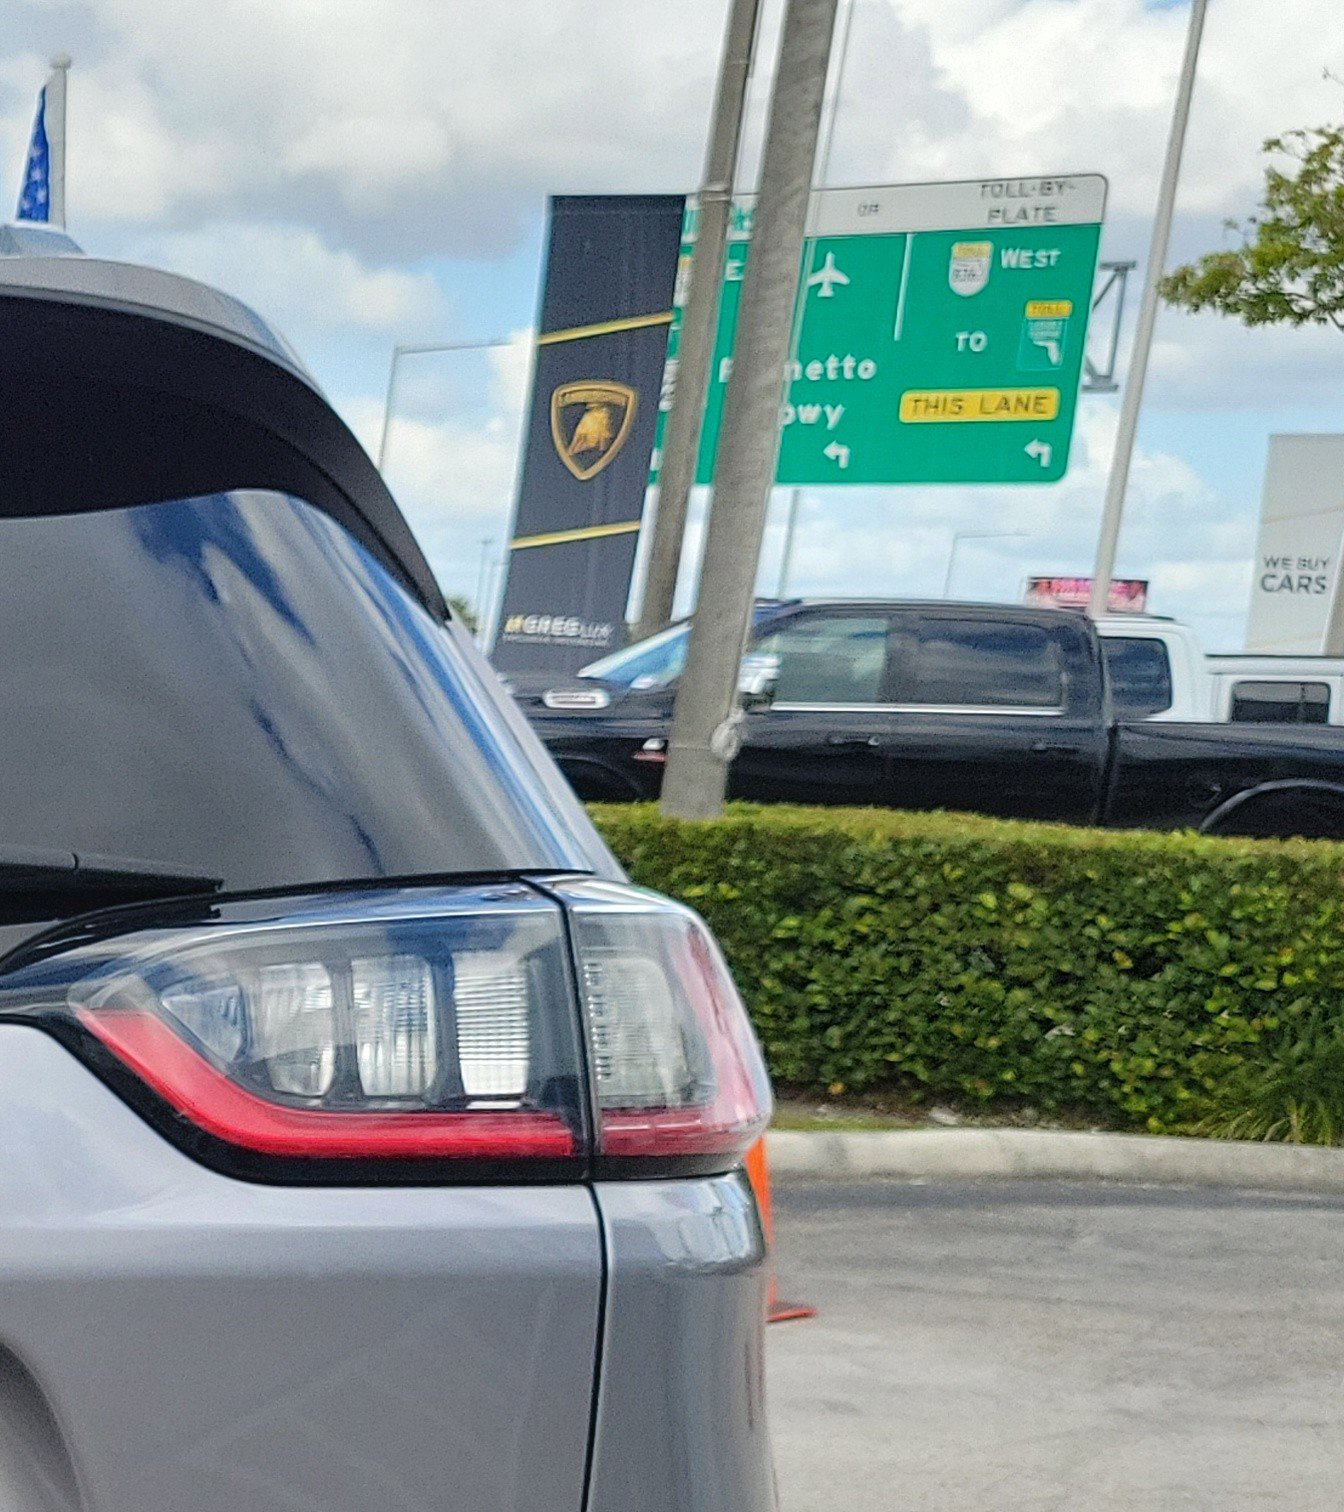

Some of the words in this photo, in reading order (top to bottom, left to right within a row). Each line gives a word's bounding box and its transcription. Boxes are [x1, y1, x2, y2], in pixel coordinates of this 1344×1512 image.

[987, 206, 1059, 224] PLATE
[1000, 247, 1062, 269] WEST
[955, 330, 988, 352] TO
[911, 396, 964, 417] THIS
[979, 393, 1048, 415] LANE
[1263, 555, 1292, 571] WE
[1296, 556, 1331, 571] BUY
[1260, 574, 1327, 595] CARS
